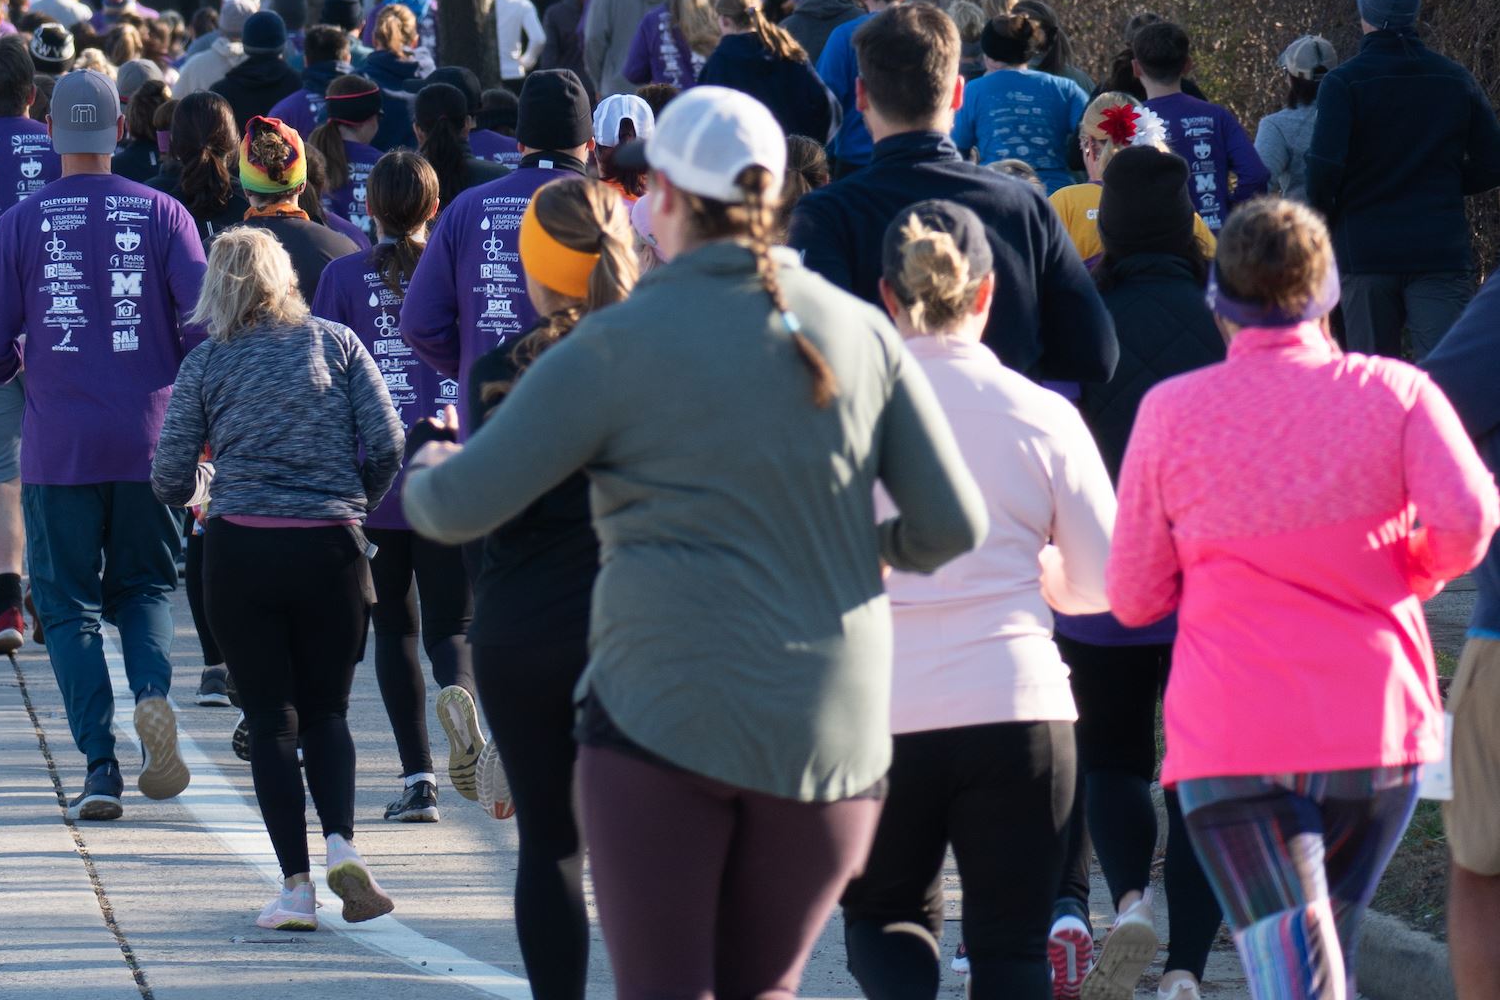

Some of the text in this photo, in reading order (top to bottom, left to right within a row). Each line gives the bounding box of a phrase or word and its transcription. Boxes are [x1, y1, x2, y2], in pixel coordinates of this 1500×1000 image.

[1195, 173, 1217, 193] M
[40, 197, 88, 208] FOLEYGRIFFIN
[118, 196, 152, 206] JOSEPH
[111, 272, 142, 295] M
[53, 296, 77, 307] EXIT
[488, 300, 512, 311] EXIT
[112, 329, 139, 343] SAL
